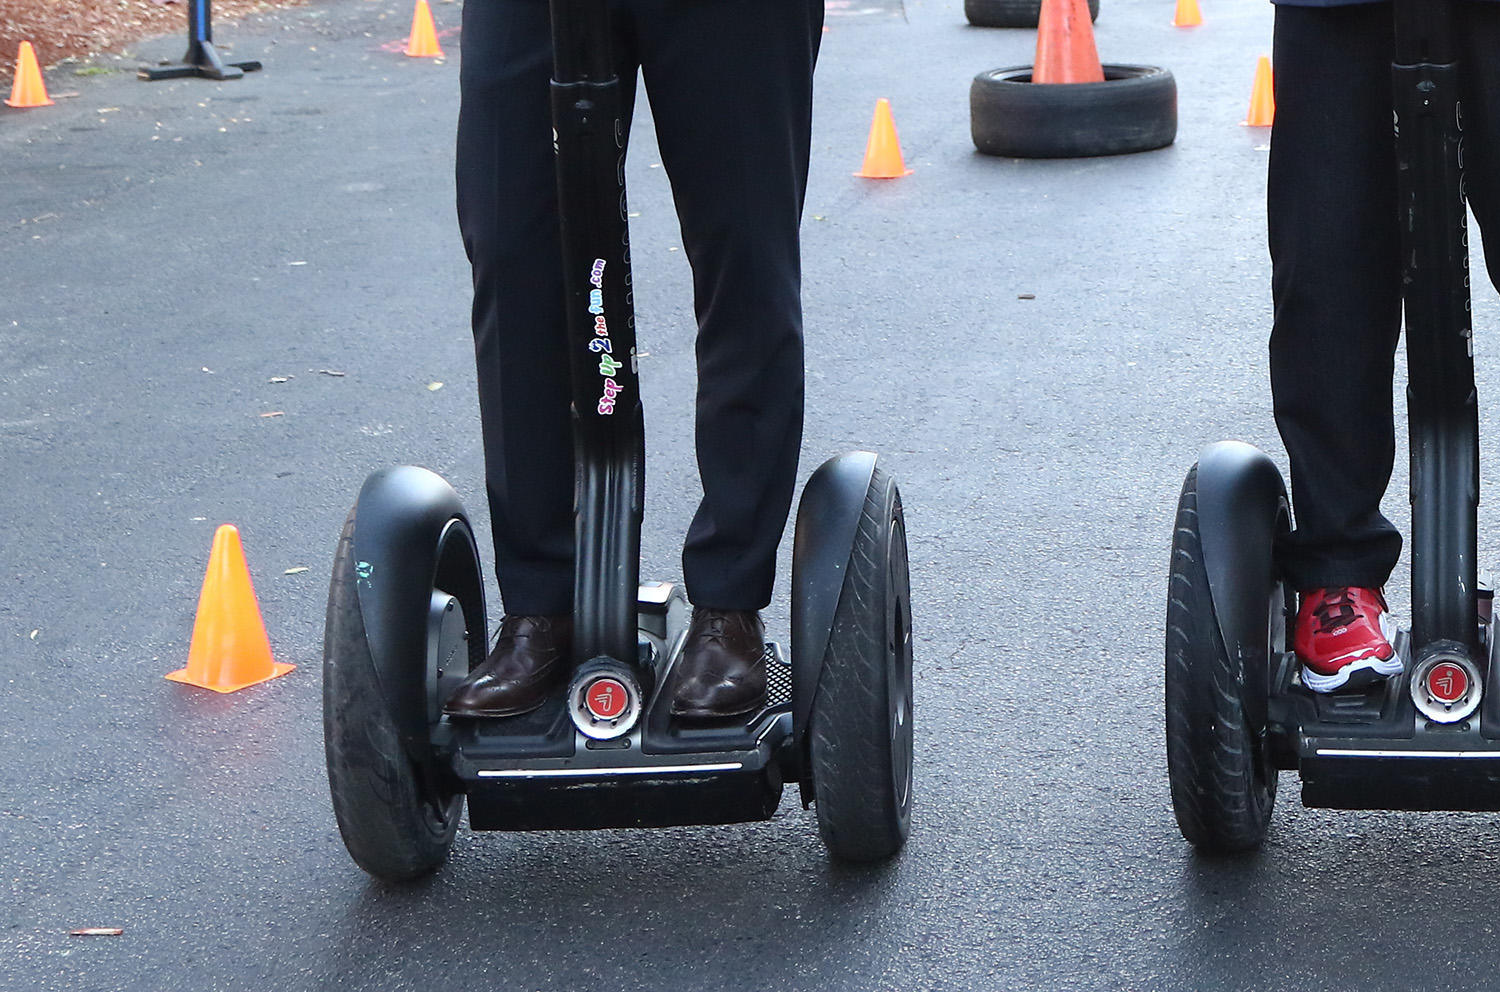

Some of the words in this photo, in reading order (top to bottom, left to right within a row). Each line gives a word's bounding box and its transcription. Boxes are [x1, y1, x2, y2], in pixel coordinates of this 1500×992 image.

[594, 316, 608, 337] the
[589, 338, 612, 354] 2
[599, 354, 622, 377] Up
[598, 378, 624, 415] Step
